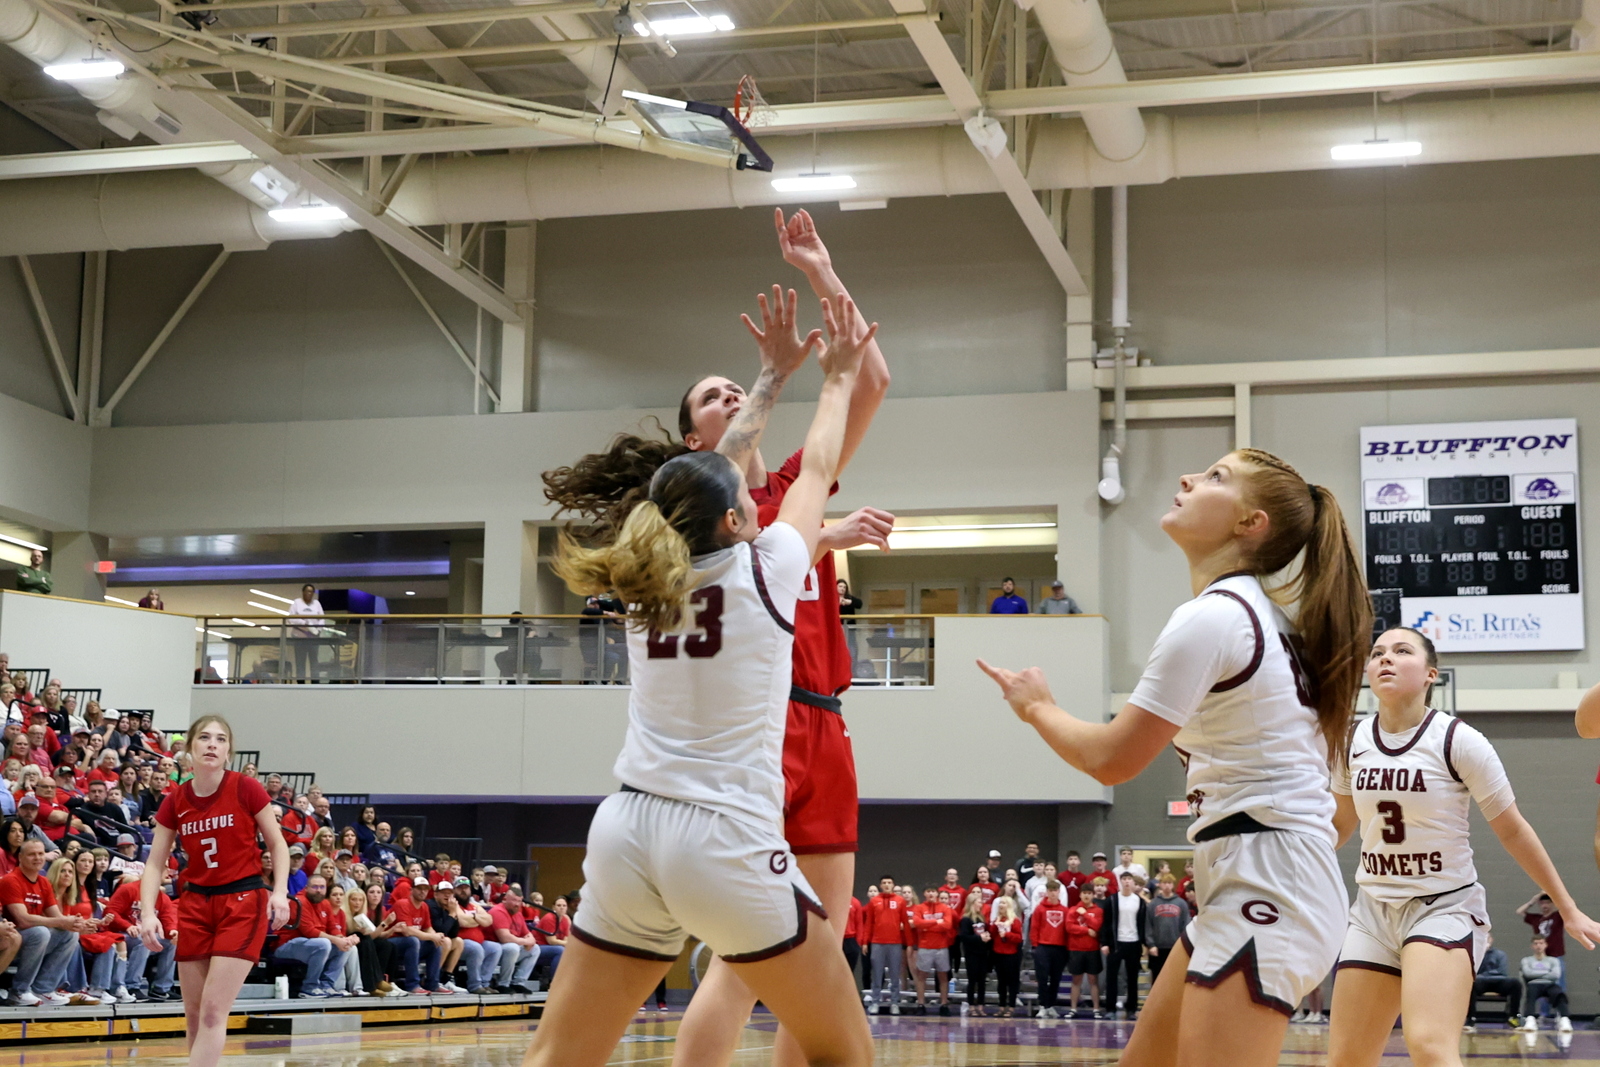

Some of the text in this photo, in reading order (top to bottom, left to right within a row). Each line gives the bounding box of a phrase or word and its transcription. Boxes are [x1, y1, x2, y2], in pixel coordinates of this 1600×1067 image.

[1364, 434, 1573, 457] BLUFFTON
[1376, 451, 1549, 463] UNIVERSITY
[1369, 510, 1431, 524] BLUFFTON
[1521, 506, 1563, 519] GUEST
[1454, 515, 1485, 525] PERIOD
[1374, 554, 1402, 564] FOULS
[1441, 551, 1499, 562] PLAYER FOUL
[1540, 549, 1569, 560] FOULS
[1457, 585, 1488, 596] MATCH
[1541, 584, 1570, 594] SCORE
[1448, 631, 1541, 641] HEALTH PARTNERS
[1356, 767, 1427, 792] GENOA
[182, 814, 233, 835] BELLEVUE
[1377, 800, 1406, 844] 3
[201, 838, 218, 868] 2
[769, 850, 788, 874] G
[1361, 851, 1442, 876] COMETS
[1241, 899, 1280, 925] G
